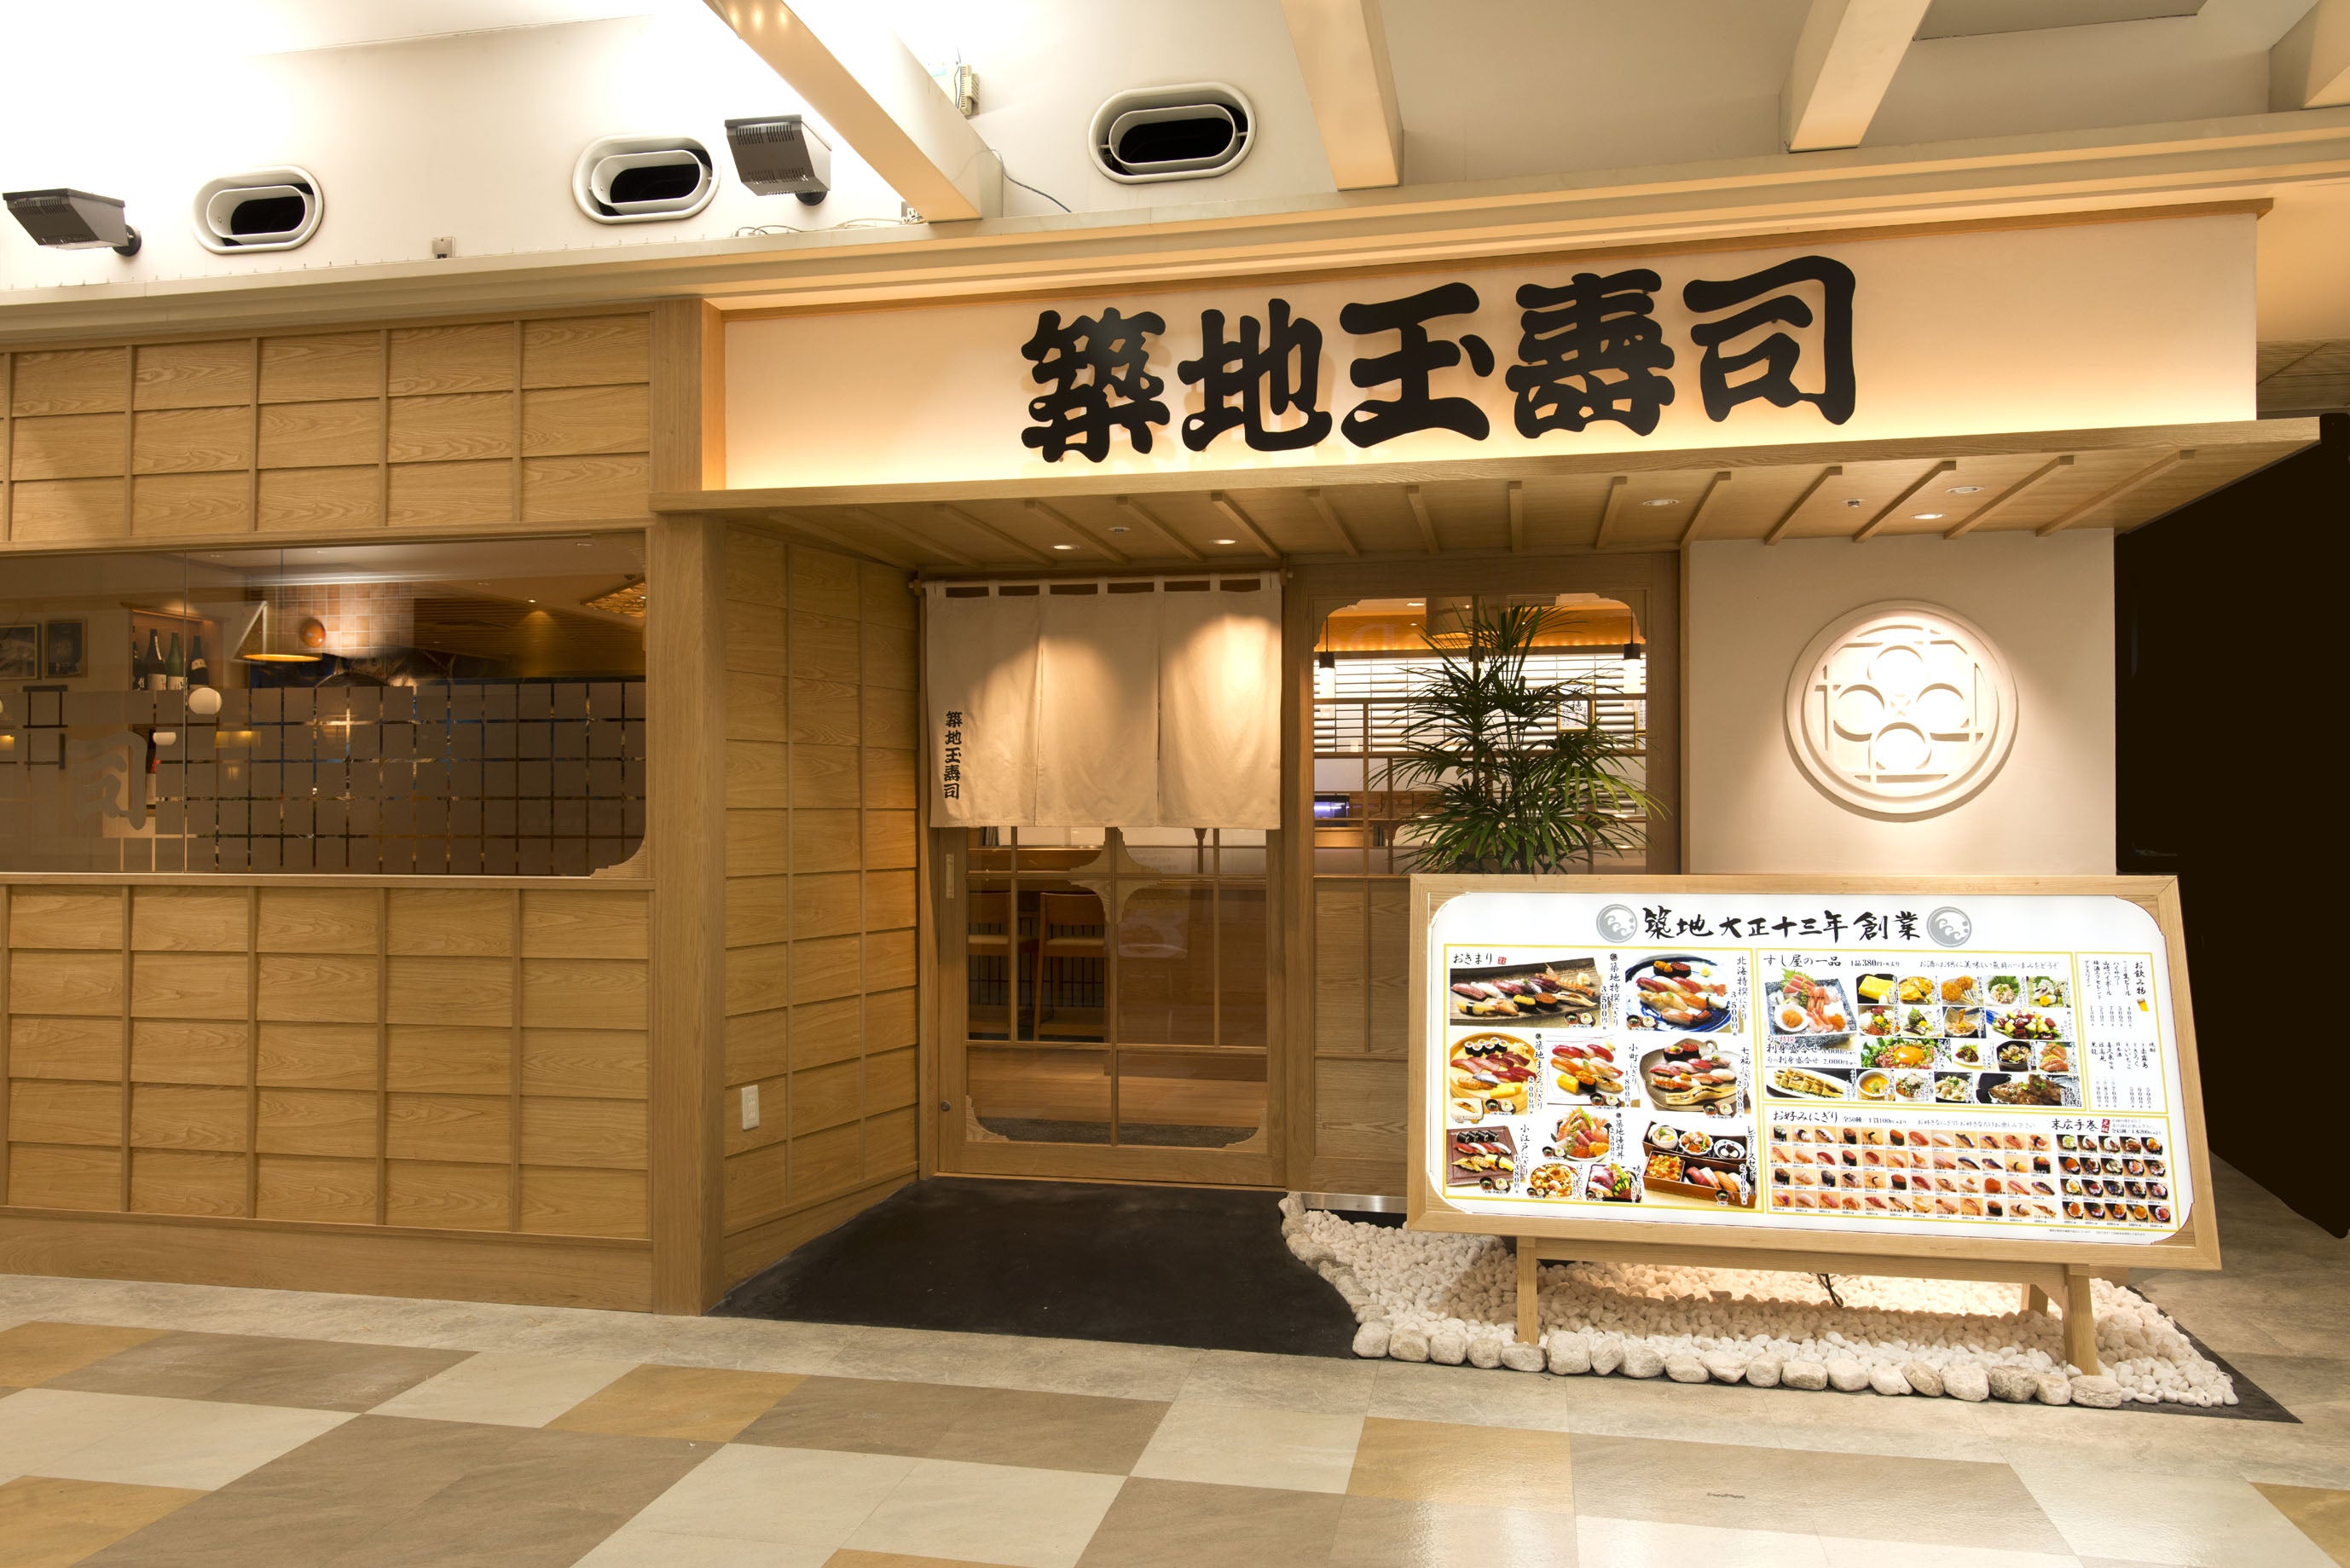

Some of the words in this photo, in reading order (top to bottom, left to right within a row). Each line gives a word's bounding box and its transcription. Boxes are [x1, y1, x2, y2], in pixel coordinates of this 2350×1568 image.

[1453, 952, 1492, 965] おきまり
[1763, 954, 1842, 968] すし屋の一品
[1774, 1111, 1838, 1123] お好みにぎり
